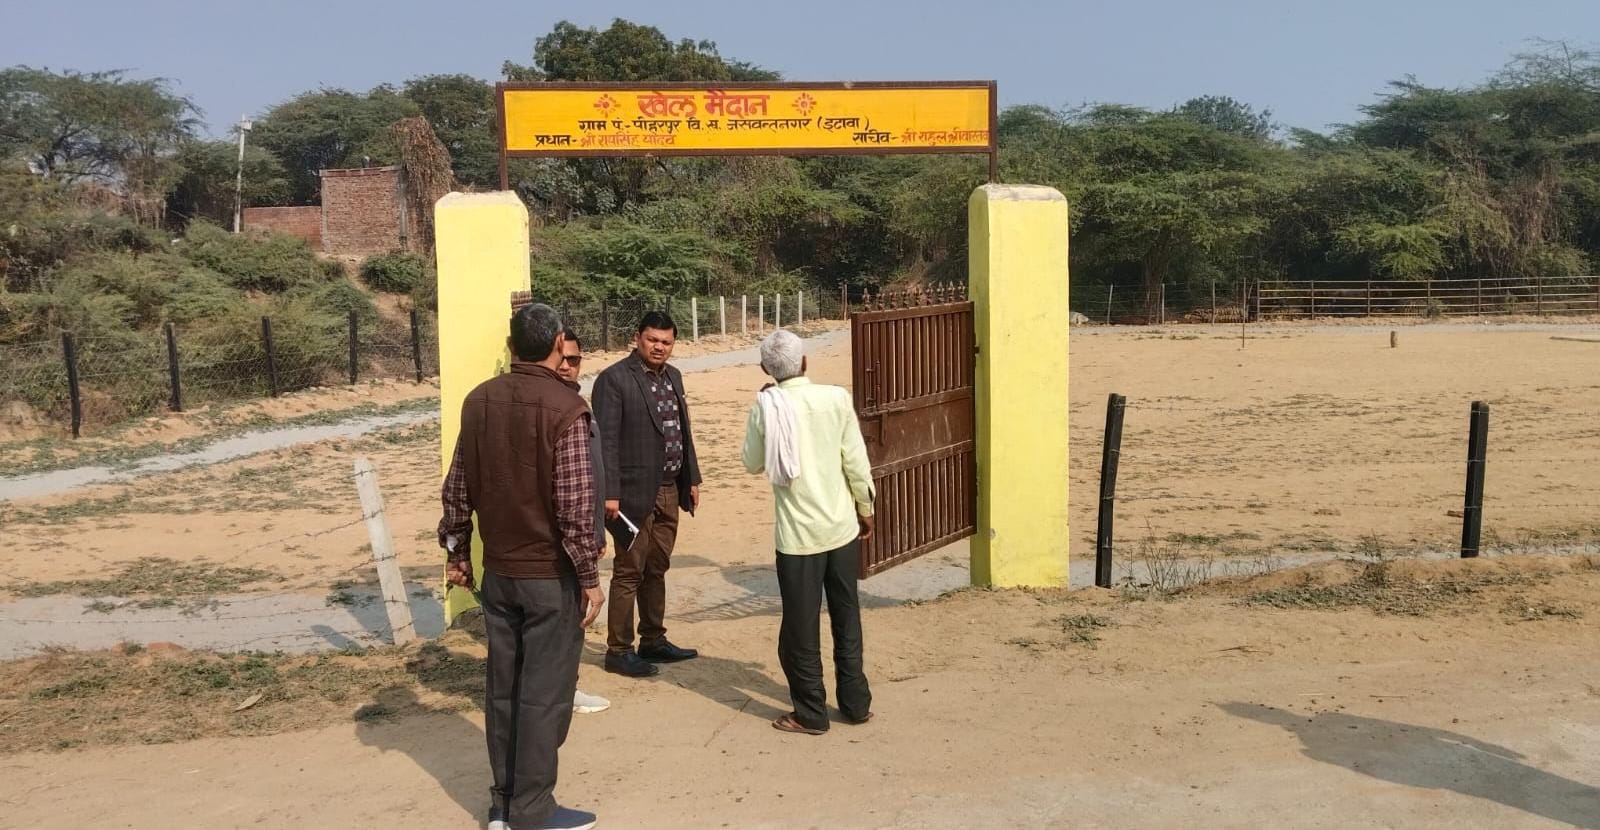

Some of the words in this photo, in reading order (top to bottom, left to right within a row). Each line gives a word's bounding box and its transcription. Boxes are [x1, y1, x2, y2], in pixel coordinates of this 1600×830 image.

[637, 90, 697, 118] खेल
[703, 89, 770, 118] मैदान
[578, 120, 607, 133] ग्राम
